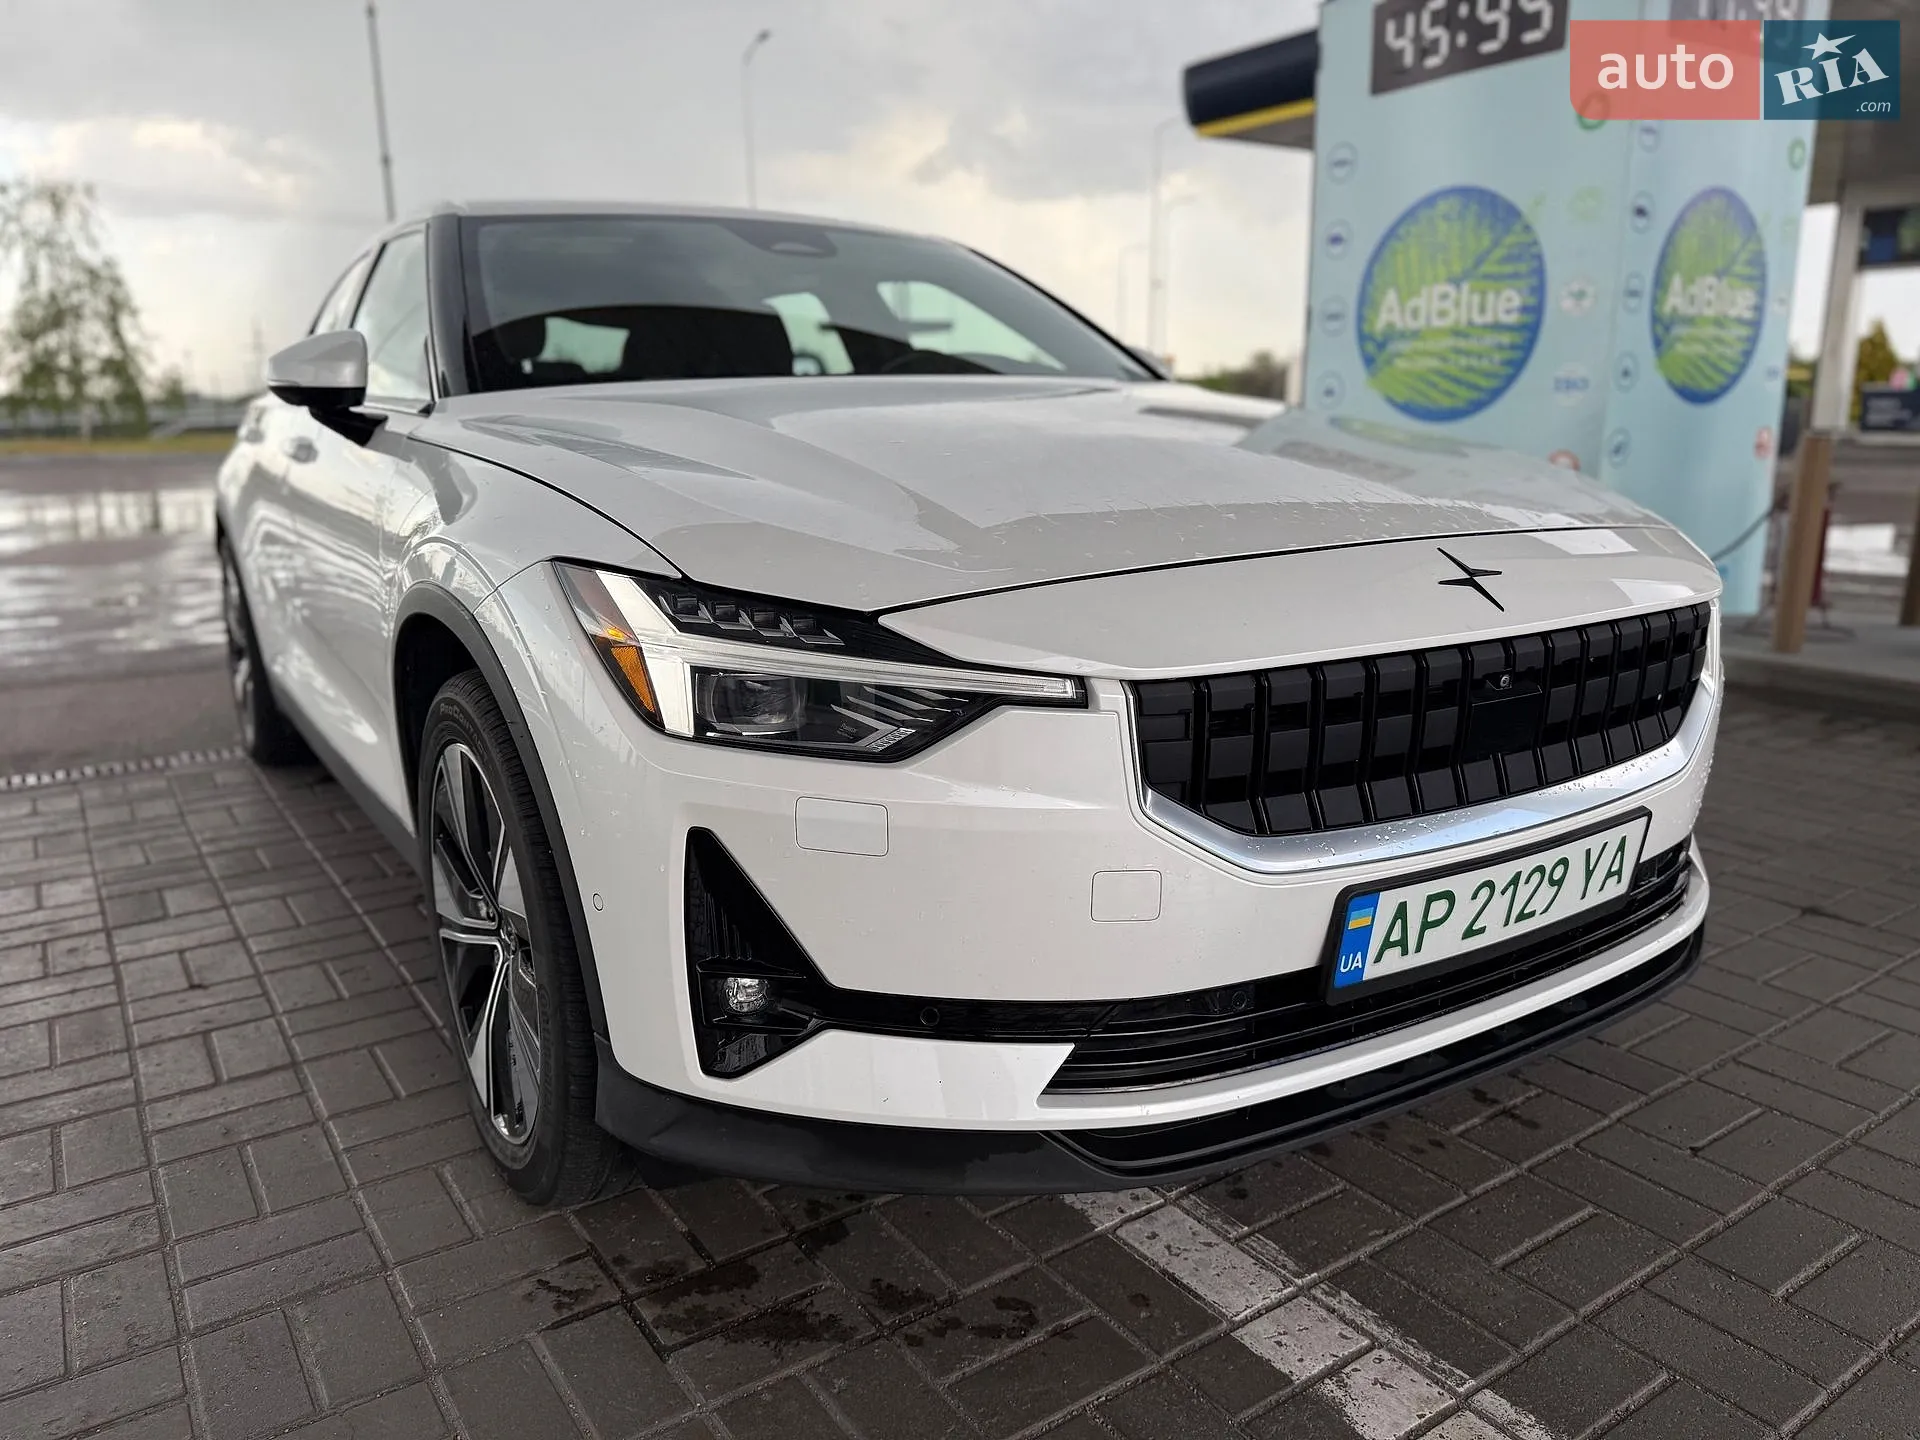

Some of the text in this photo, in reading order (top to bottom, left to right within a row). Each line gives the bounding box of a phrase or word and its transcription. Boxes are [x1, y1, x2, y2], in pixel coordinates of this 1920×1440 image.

[1375, 280, 1522, 333] AdBlue
[1662, 272, 1757, 318] AdBlue
[1373, 835, 1627, 964] AP 2129 YA
[1340, 952, 1363, 973] UA
